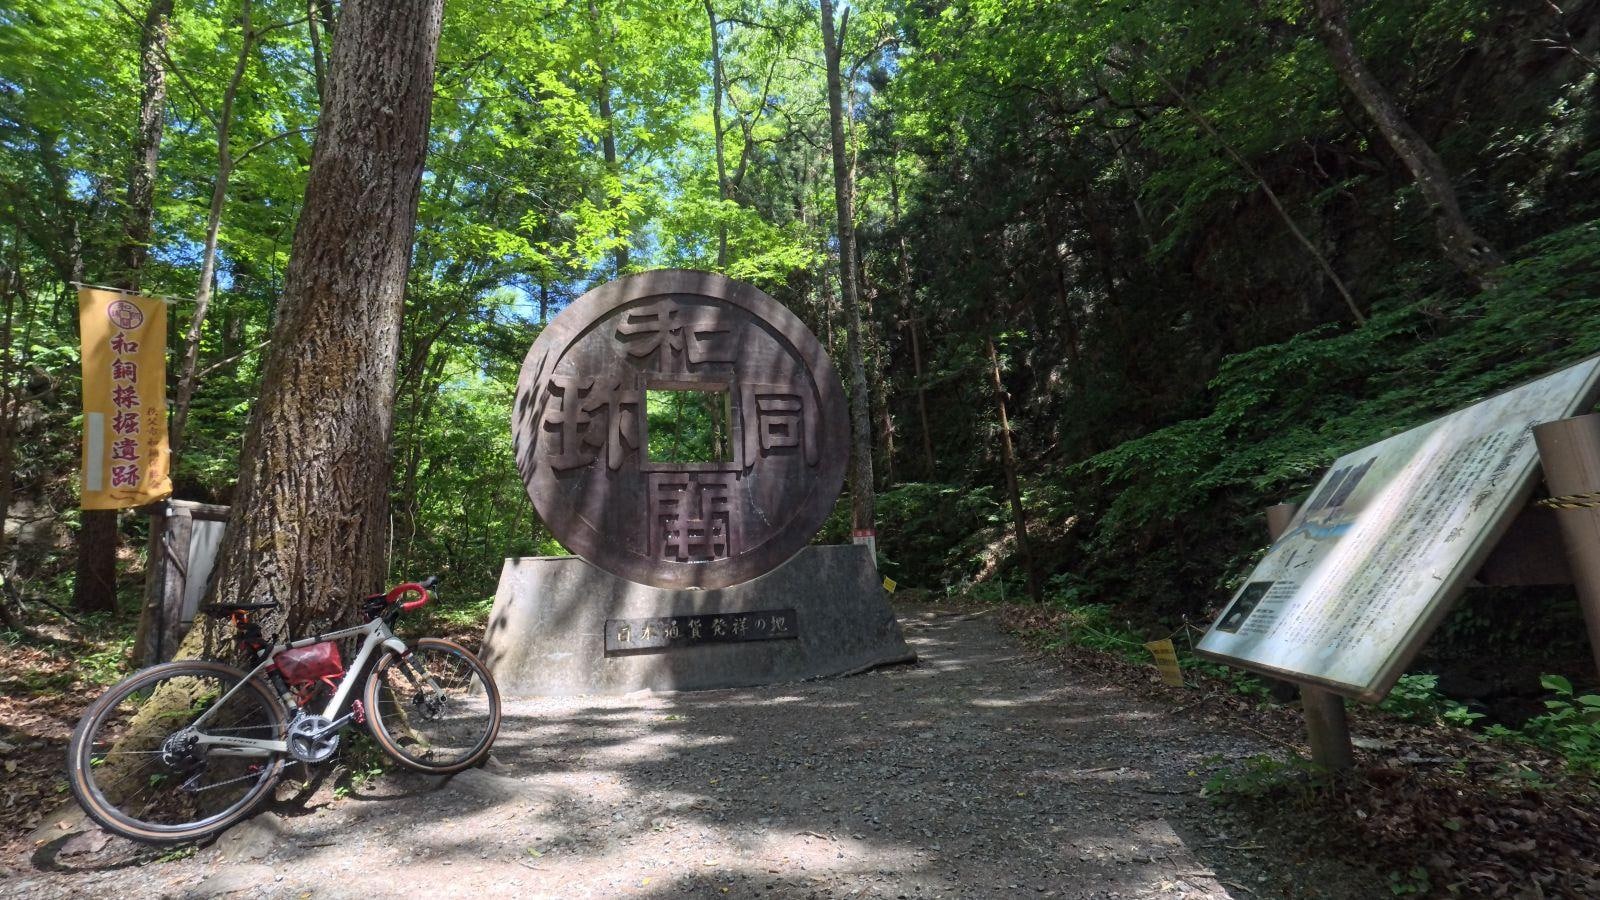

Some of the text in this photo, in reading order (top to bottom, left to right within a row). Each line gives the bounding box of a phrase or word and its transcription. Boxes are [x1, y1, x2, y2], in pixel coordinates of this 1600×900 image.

[615, 299, 740, 373] 和
[111, 332, 140, 488] 和銅採掘遺跡
[741, 384, 819, 468] 同
[617, 615, 788, 643] 日本通貨発祥の地
